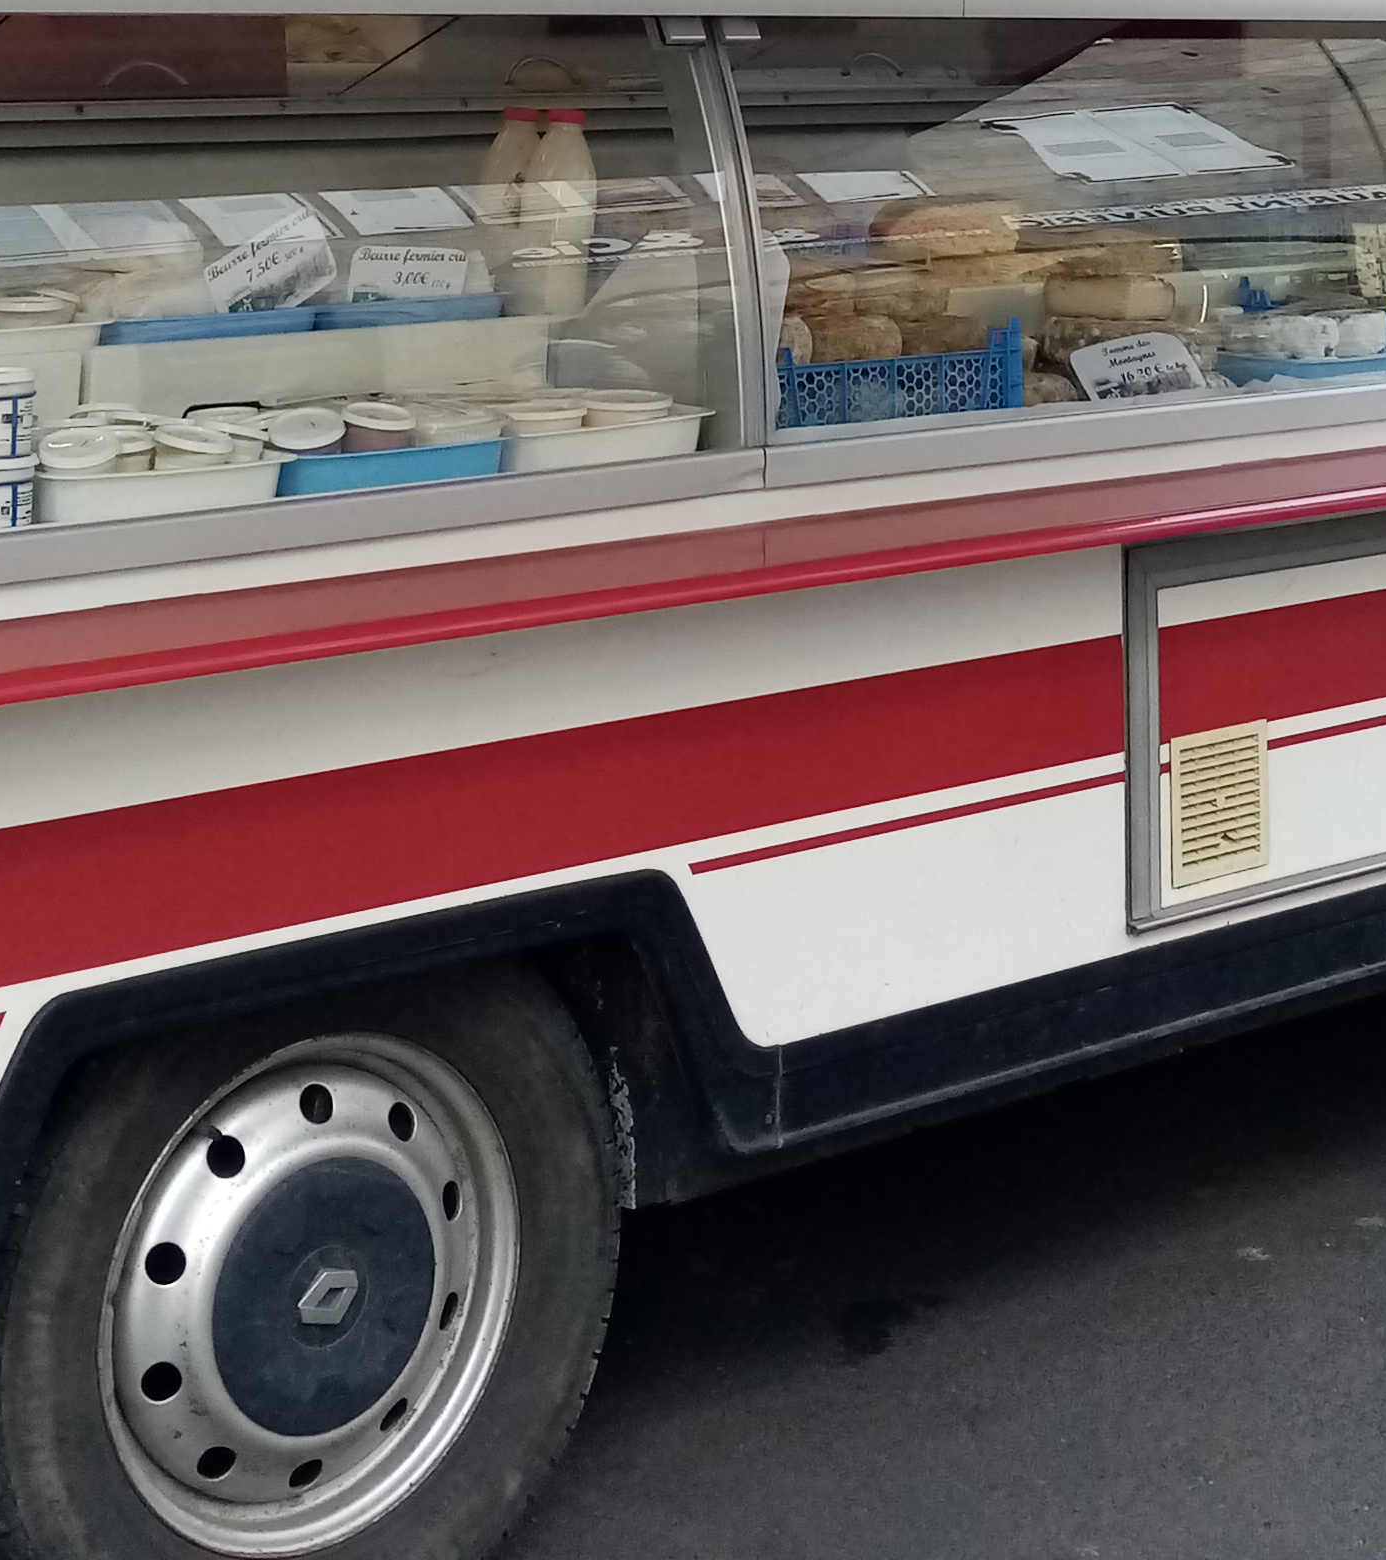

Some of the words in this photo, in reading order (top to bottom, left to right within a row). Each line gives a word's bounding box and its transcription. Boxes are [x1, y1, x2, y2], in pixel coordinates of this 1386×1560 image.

[207, 251, 249, 283] Beurre
[249, 220, 290, 259] fermier
[358, 247, 400, 262] Beurre
[402, 248, 445, 266] fermier
[448, 253, 467, 263] cru
